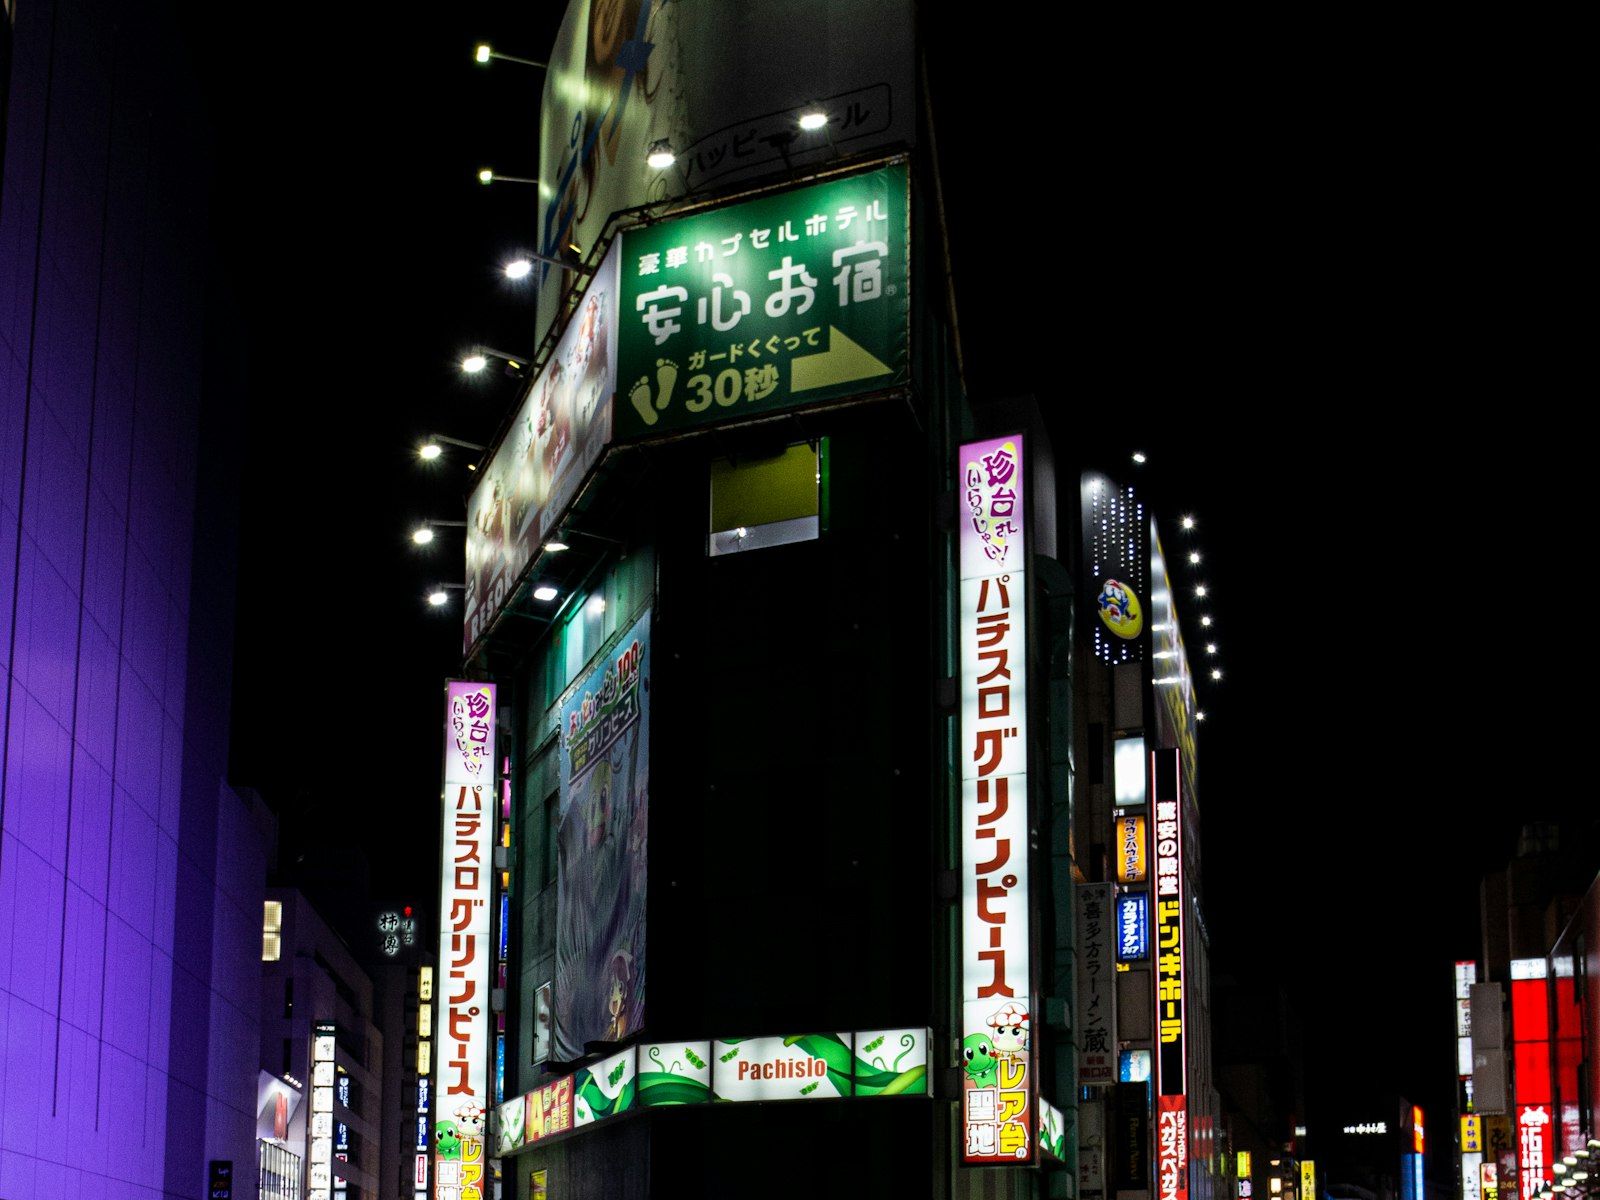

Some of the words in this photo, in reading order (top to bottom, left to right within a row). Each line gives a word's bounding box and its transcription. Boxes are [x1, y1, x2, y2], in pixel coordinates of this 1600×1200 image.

[686, 102, 870, 181] ハッピール
[638, 200, 888, 276] 豪華カプセルホテル
[636, 240, 889, 346] 安心お宿
[688, 327, 821, 370] ガードくぐって
[685, 365, 780, 413] 30秒
[1083, 901, 1110, 1053] 喜多方ラーメン蔵
[737, 1057, 827, 1081] Pachislo
[966, 1089, 999, 1158] 聖地
